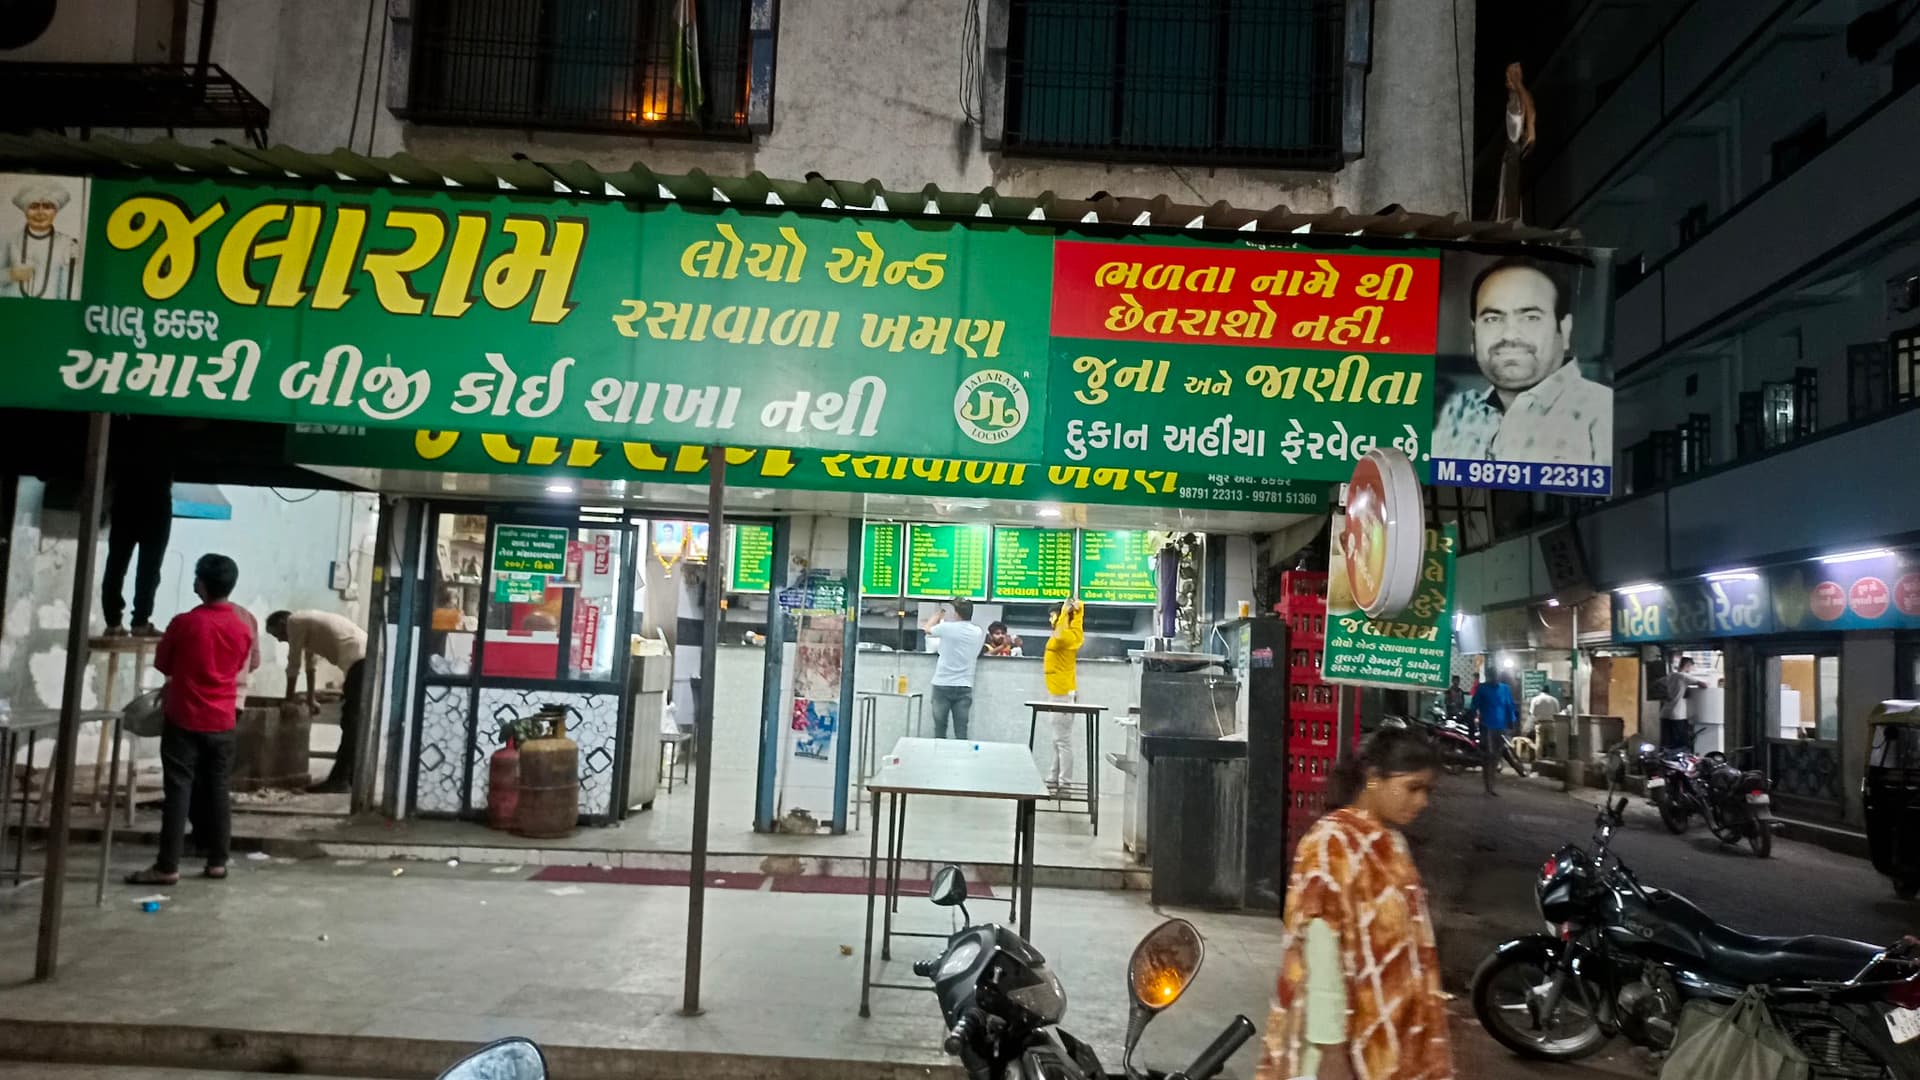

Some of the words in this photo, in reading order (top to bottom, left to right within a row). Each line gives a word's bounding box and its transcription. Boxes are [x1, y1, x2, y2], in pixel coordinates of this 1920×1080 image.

[106, 194, 590, 324] જલારામ
[681, 224, 807, 284] લોચો
[824, 232, 947, 290] એન્ડ
[1094, 261, 1236, 294] ભળતા
[1250, 259, 1340, 298] નામે
[1355, 263, 1414, 302] થી
[83, 305, 147, 350] લાલુ
[153, 309, 219, 342] ઠક્કર
[612, 300, 841, 350] રસાવાળા
[860, 312, 1006, 360] ખમણ
[1104, 294, 1278, 339] છેતરાશો
[59, 339, 261, 402] અમારી
[279, 344, 431, 420] બીજી
[450, 352, 576, 418] કોઈ
[585, 376, 742, 430] શાખા
[760, 375, 888, 438] નથી
[964, 372, 1020, 394] JALARAM
[1072, 356, 1170, 405] જુના
[1183, 369, 1233, 397] અને
[1245, 354, 1422, 406] જાણીતા
[971, 428, 1009, 441] LOCHO
[1064, 419, 1148, 461] દુકાન
[1163, 414, 1265, 457] અહીંયા
[1179, 487, 1209, 499] 98791
[1212, 489, 1243, 501] 22313
[1252, 490, 1283, 503] 99781
[1286, 492, 1317, 505] 51360
[1437, 460, 1463, 481] M.
[1469, 462, 1531, 485] 98791
[1539, 465, 1605, 488] 22313
[1339, 617, 1439, 642] જલારામ
[1617, 592, 1661, 638] પટેલ
